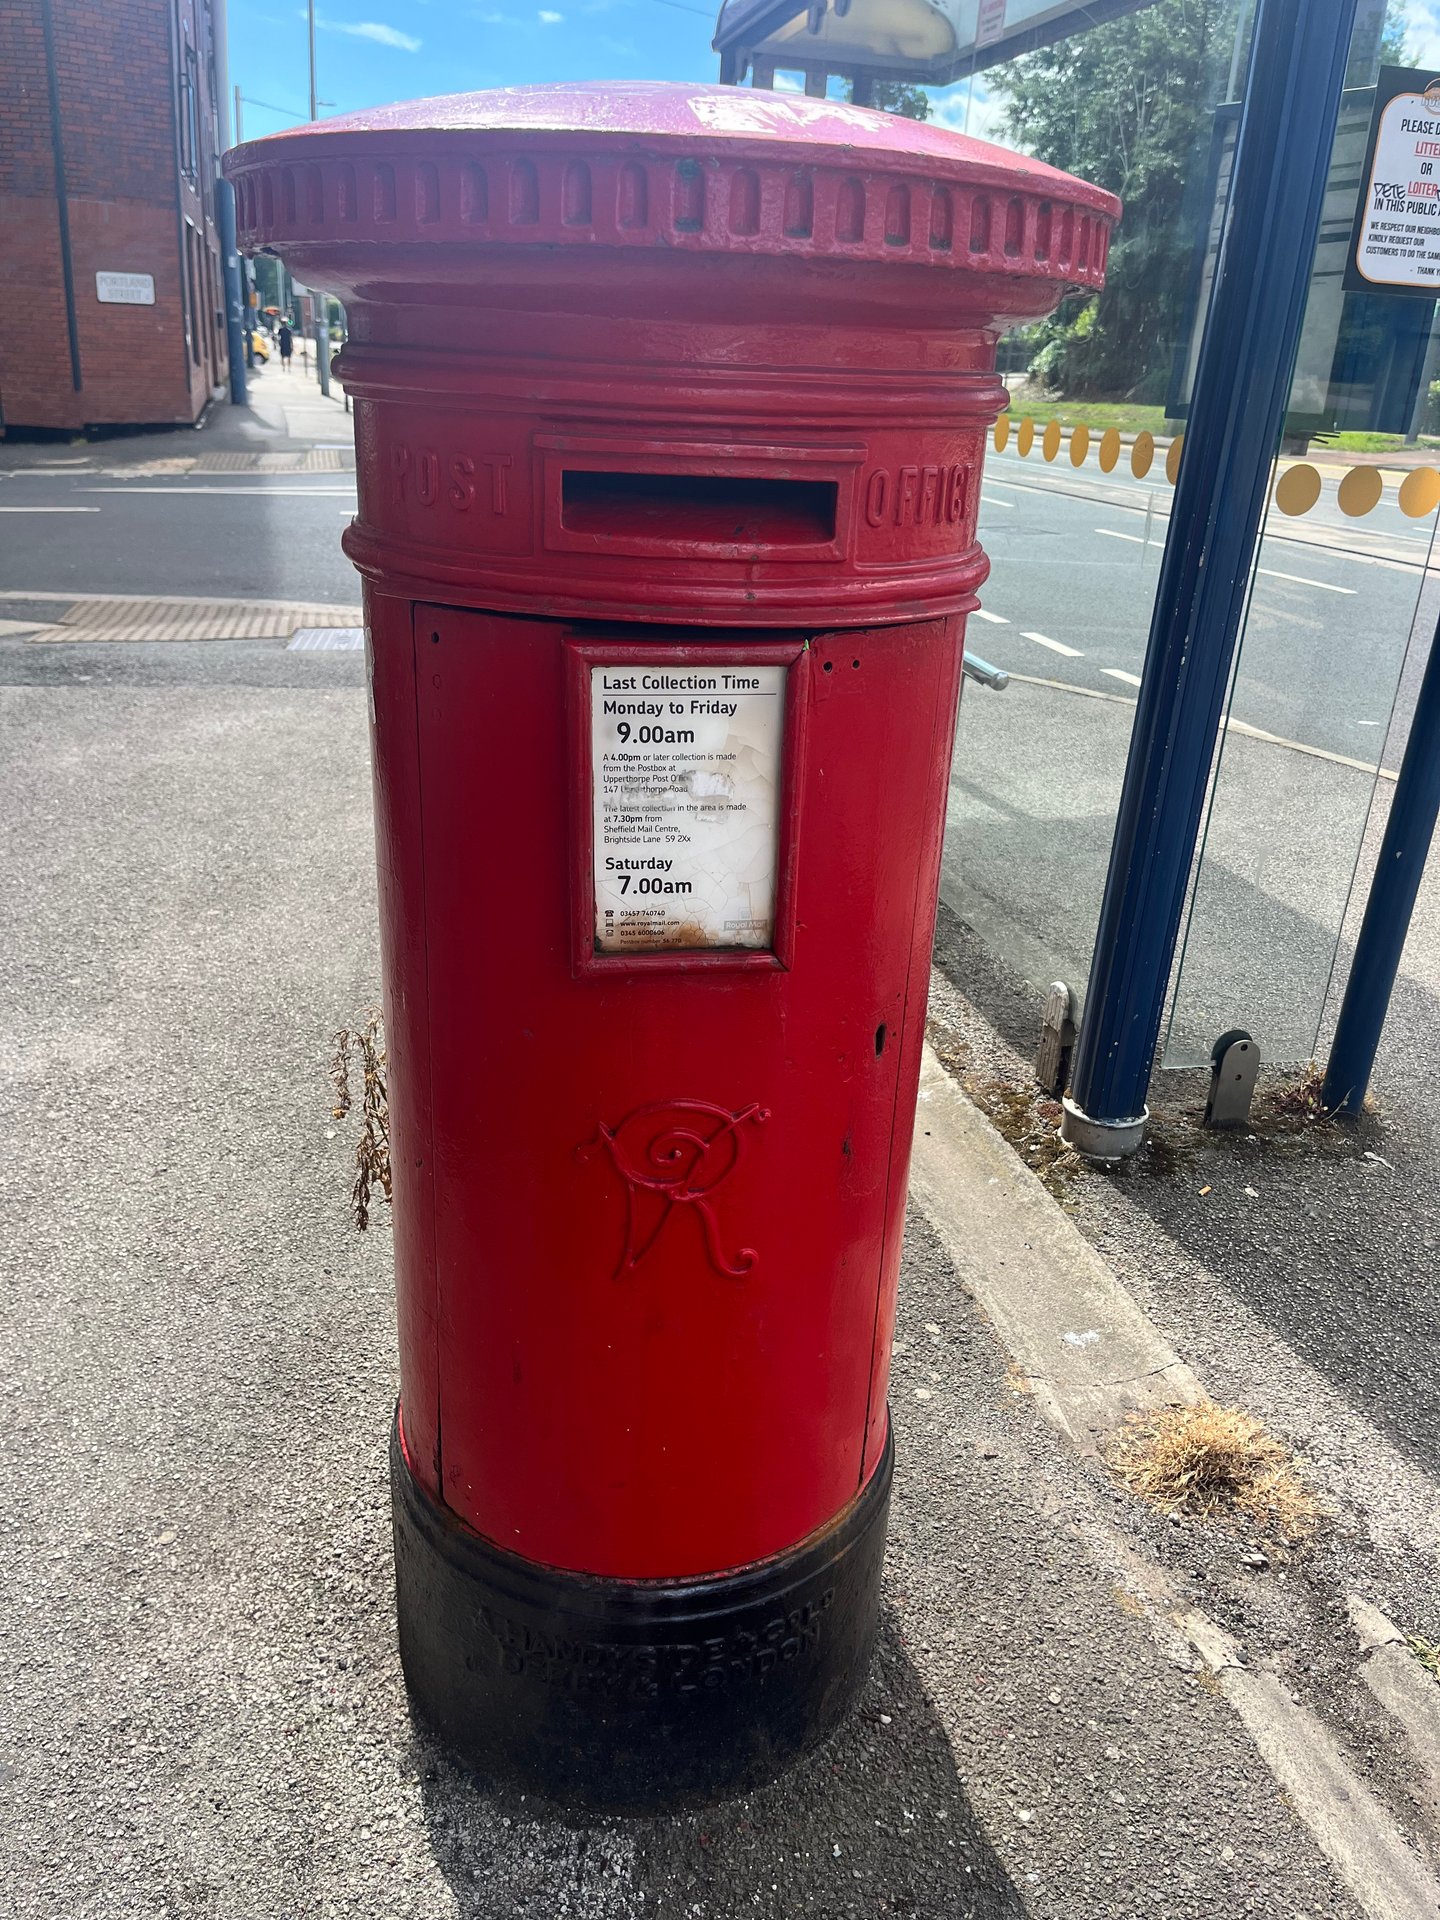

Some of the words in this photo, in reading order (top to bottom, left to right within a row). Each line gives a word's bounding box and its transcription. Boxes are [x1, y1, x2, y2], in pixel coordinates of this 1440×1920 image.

[1400, 118, 1434, 135] PLEASE
[1420, 161, 1433, 176] OR
[1373, 198, 1384, 211] IN
[1386, 199, 1405, 213] THIS
[1406, 201, 1437, 217] PUBLIC
[1370, 221, 1380, 230] WE
[1380, 222, 1405, 232] RESPECT
[1404, 224, 1417, 234] OUR
[1368, 233, 1388, 243] KINDLY
[1388, 235, 1413, 246] REQUEST
[1413, 237, 1425, 246] OUR
[1365, 245, 1399, 257] CUSTOMERS
[1399, 248, 1407, 257] TO
[1407, 249, 1416, 258] DO
[1416, 250, 1427, 259] THE
[1416, 266, 1436, 276] THANK
[391, 443, 514, 516] POST
[603, 675, 637, 690] Last
[642, 675, 717, 690] Collection
[721, 675, 760, 690] Time
[603, 700, 664, 718] Monday
[668, 701, 684, 715] to
[690, 700, 738, 717] Friday
[616, 721, 695, 743] 9.00am
[602, 753, 609, 761] A
[610, 753, 641, 762] 4.00pm
[653, 753, 670, 761] later
[671, 752, 706, 761] collection
[707, 752, 714, 760] is
[715, 752, 737, 760] made
[603, 764, 621, 772] from
[623, 763, 636, 772] the
[637, 763, 667, 772] Postbox
[668, 764, 676, 772] at
[603, 775, 651, 784] Upperthorpe
[652, 774, 669, 783] Post
[603, 785, 618, 793] 147
[669, 784, 688, 793] Road
[603, 804, 618, 812] The
[619, 804, 640, 812] latest
[641, 803, 676, 812] collection
[677, 803, 684, 811] in
[686, 803, 698, 811] the
[718, 803, 724, 811] is
[726, 802, 747, 810] made
[603, 815, 612, 823] at
[613, 814, 643, 824] 7.30pm
[644, 814, 663, 822] from
[603, 825, 636, 834] Sheffield
[637, 825, 653, 833] Mail
[654, 824, 681, 833] Centre,
[604, 835, 641, 845] Brightside
[642, 835, 661, 843] Lane
[665, 834, 676, 843] S9
[605, 856, 673, 872] Saturday
[617, 875, 693, 895] 7.00am
[620, 920, 680, 928] www.royalmail.com
